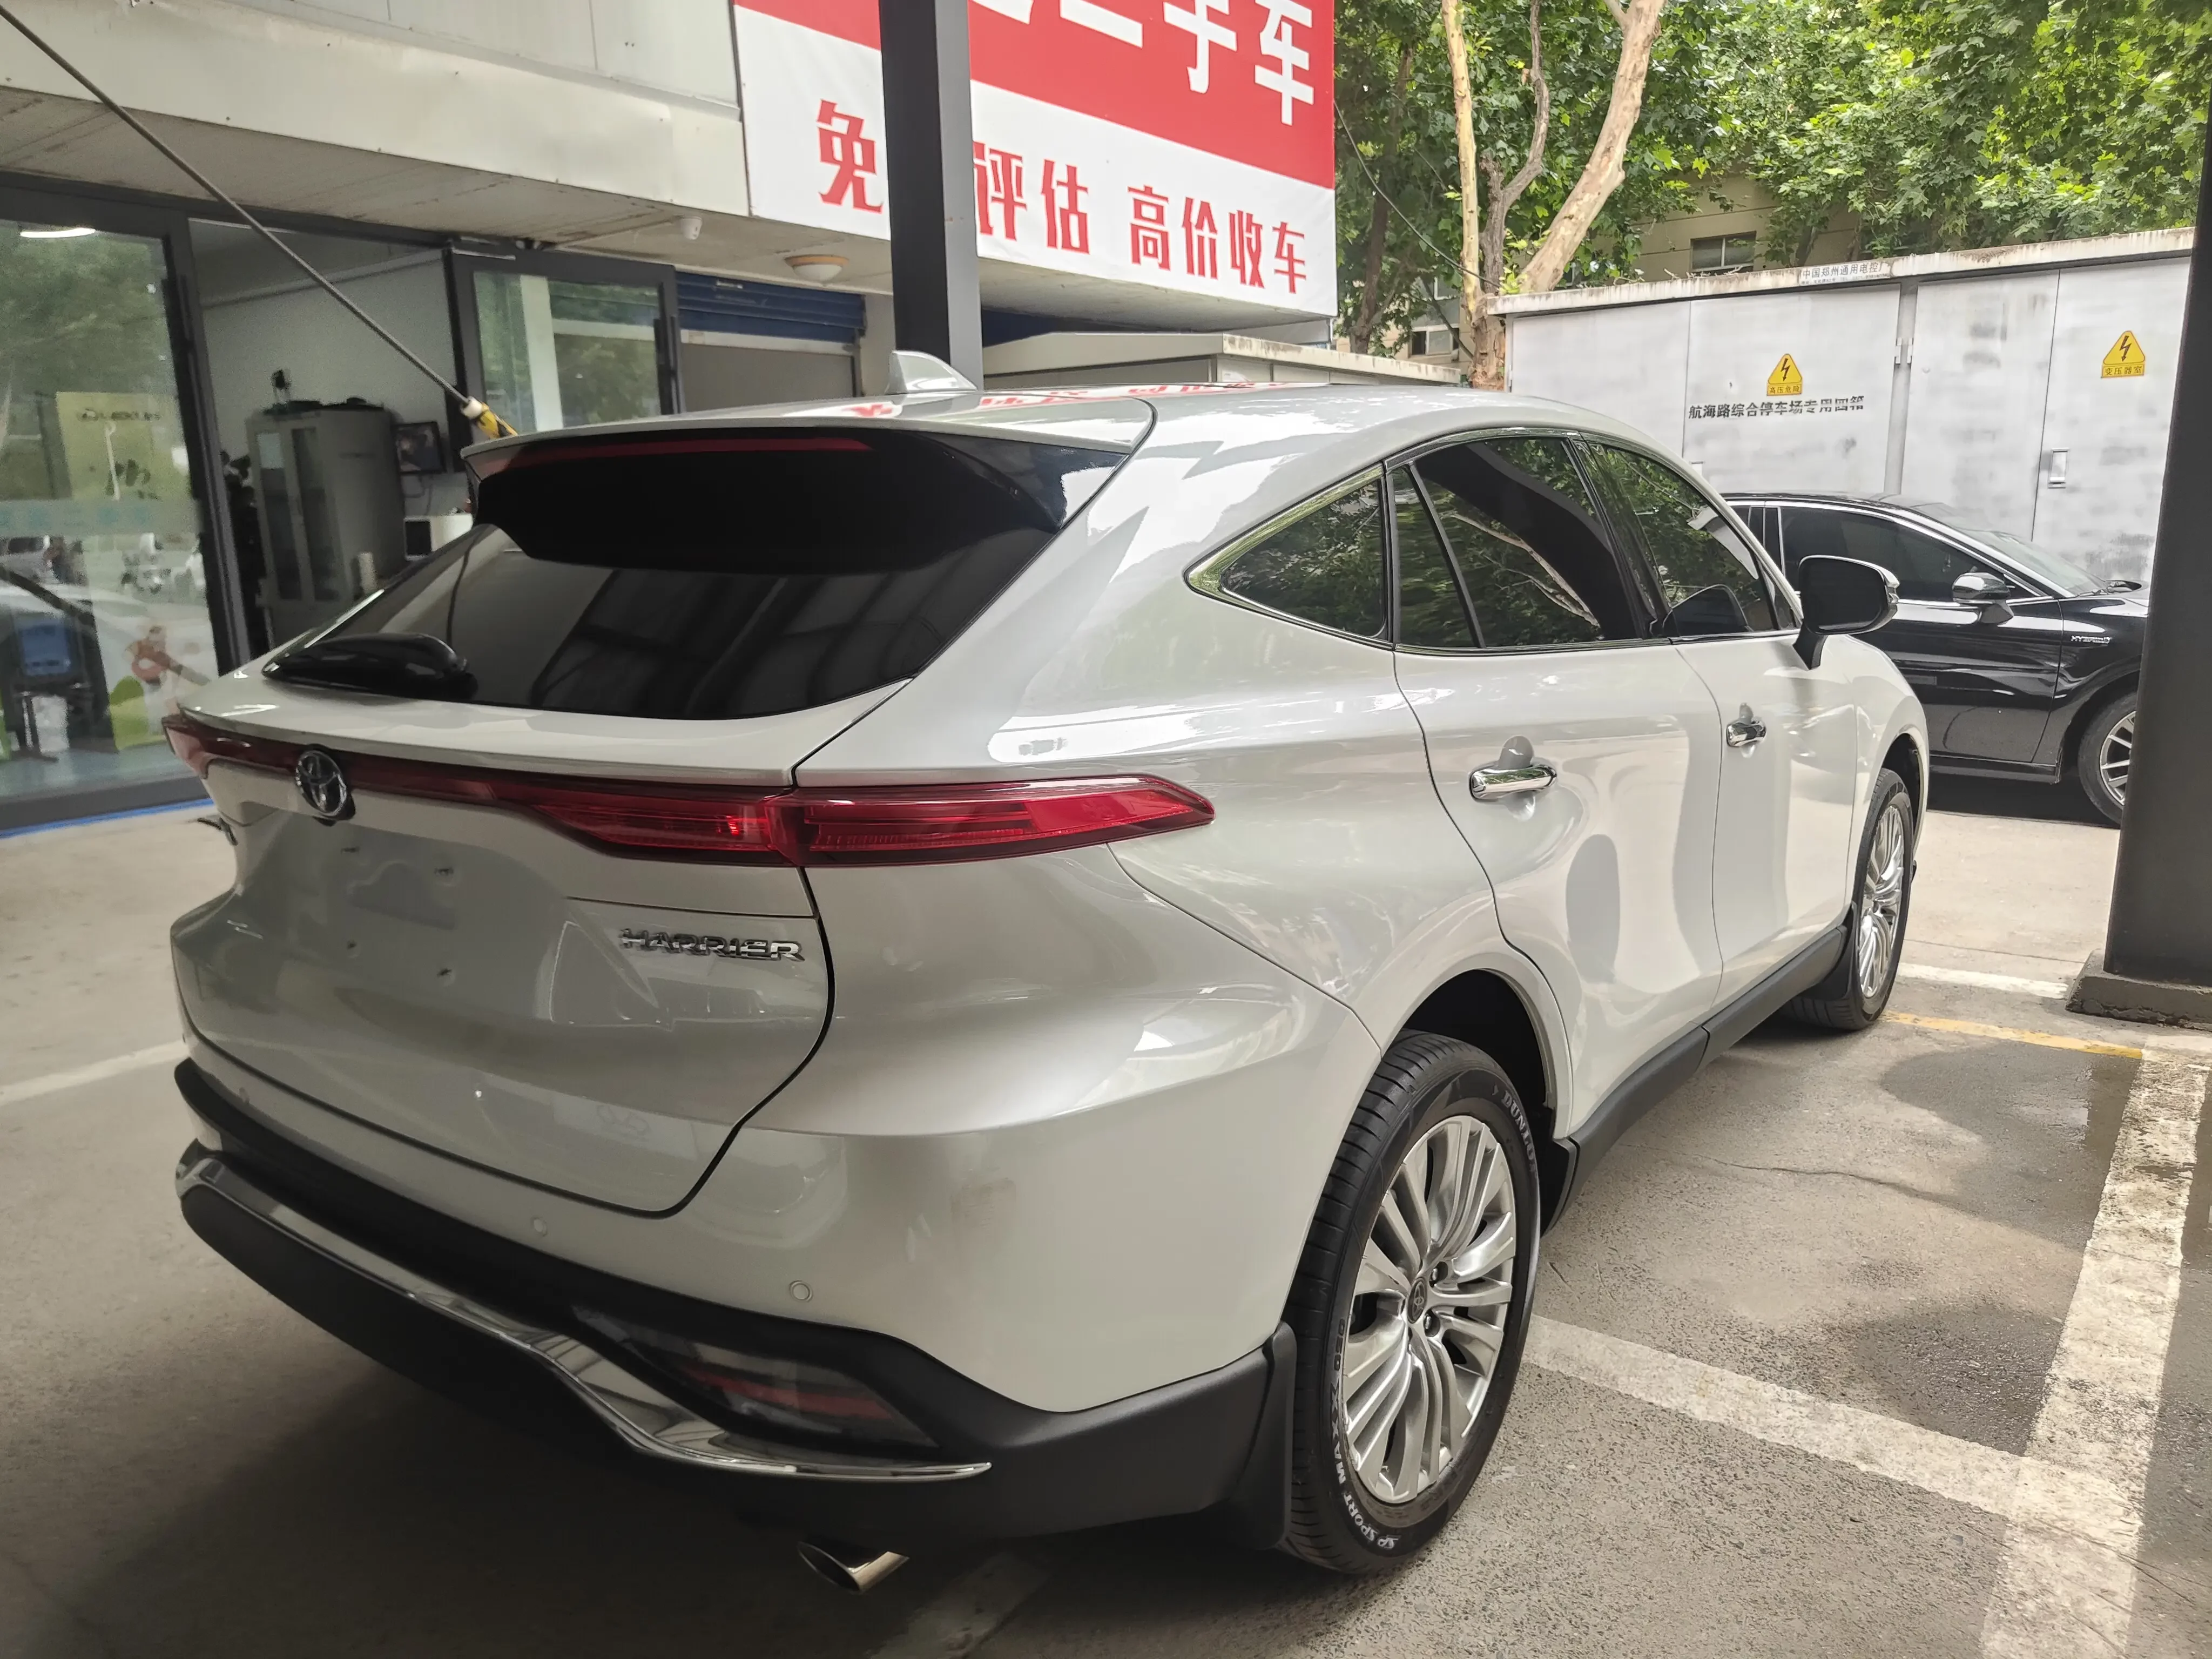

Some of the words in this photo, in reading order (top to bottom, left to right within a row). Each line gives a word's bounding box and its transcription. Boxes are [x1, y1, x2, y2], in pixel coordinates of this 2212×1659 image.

[817, 99, 1090, 254] 免评估
[1128, 185, 1306, 294] 高价收车
[2105, 366, 2142, 375] 变压器室
[1769, 385, 1800, 394] 高压危险
[2071, 635, 2110, 644] HYBRID
[621, 928, 805, 962] HARRIER
[1343, 1493, 1378, 1543] SPORT
